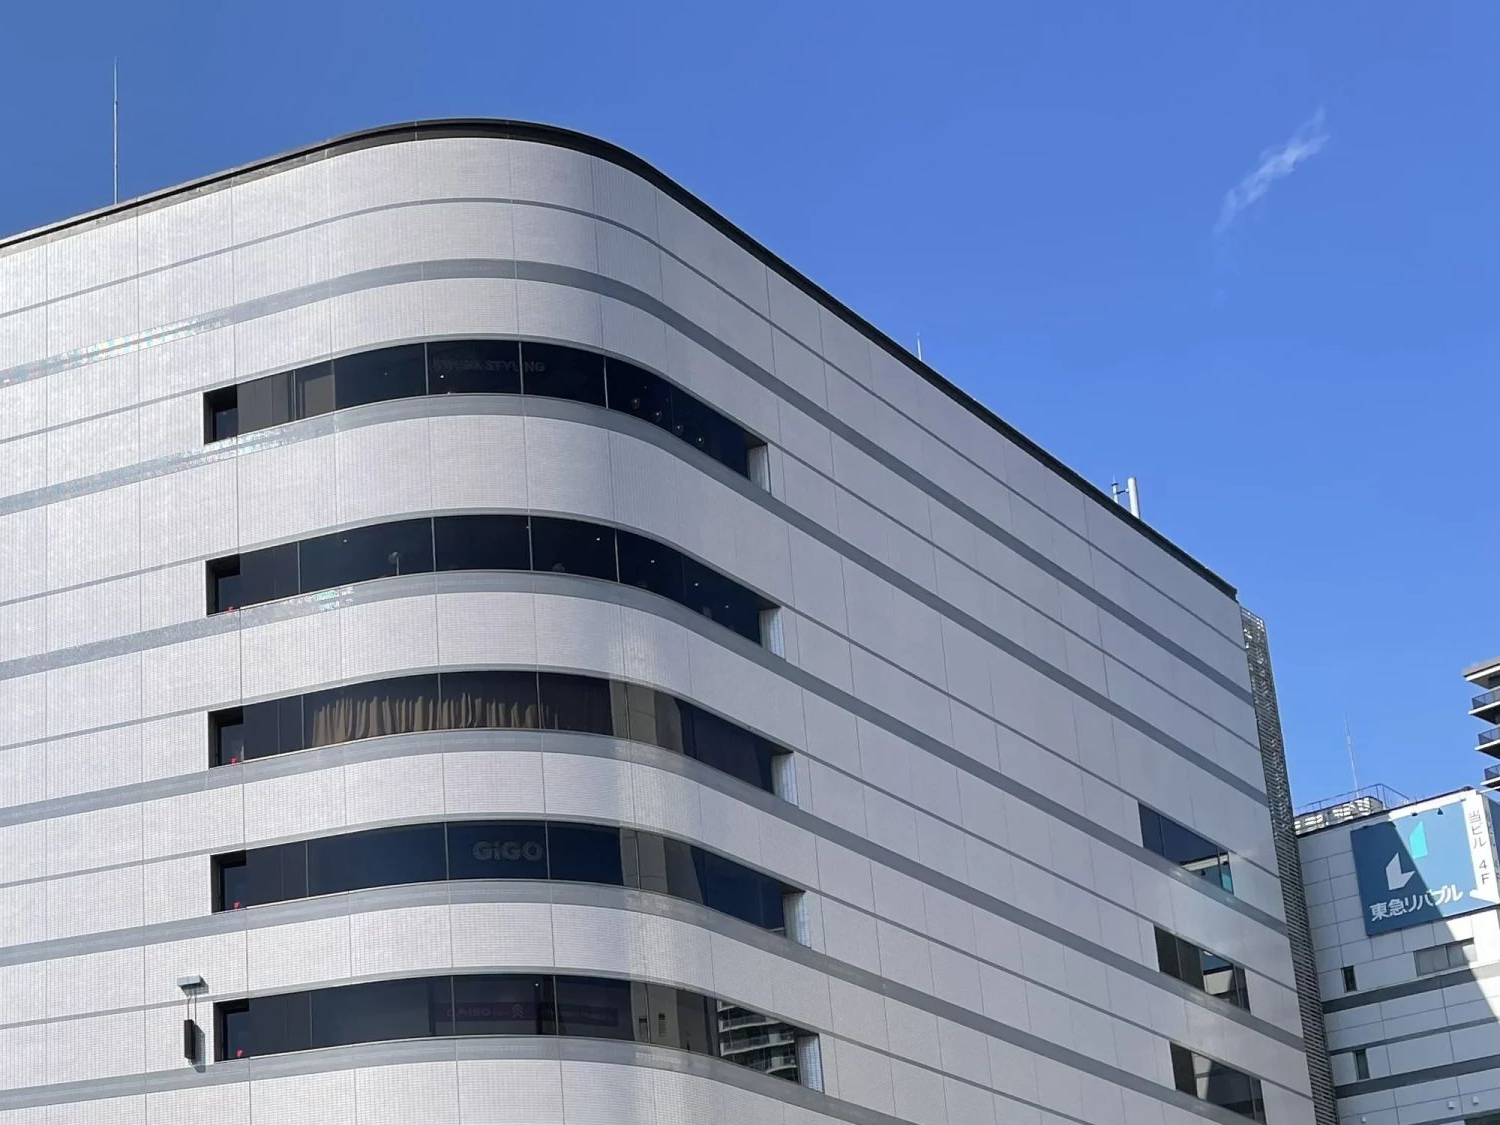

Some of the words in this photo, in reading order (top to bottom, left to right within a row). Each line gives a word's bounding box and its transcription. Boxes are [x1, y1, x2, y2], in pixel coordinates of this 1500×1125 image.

[1369, 884, 1463, 922] 東急リバブル
